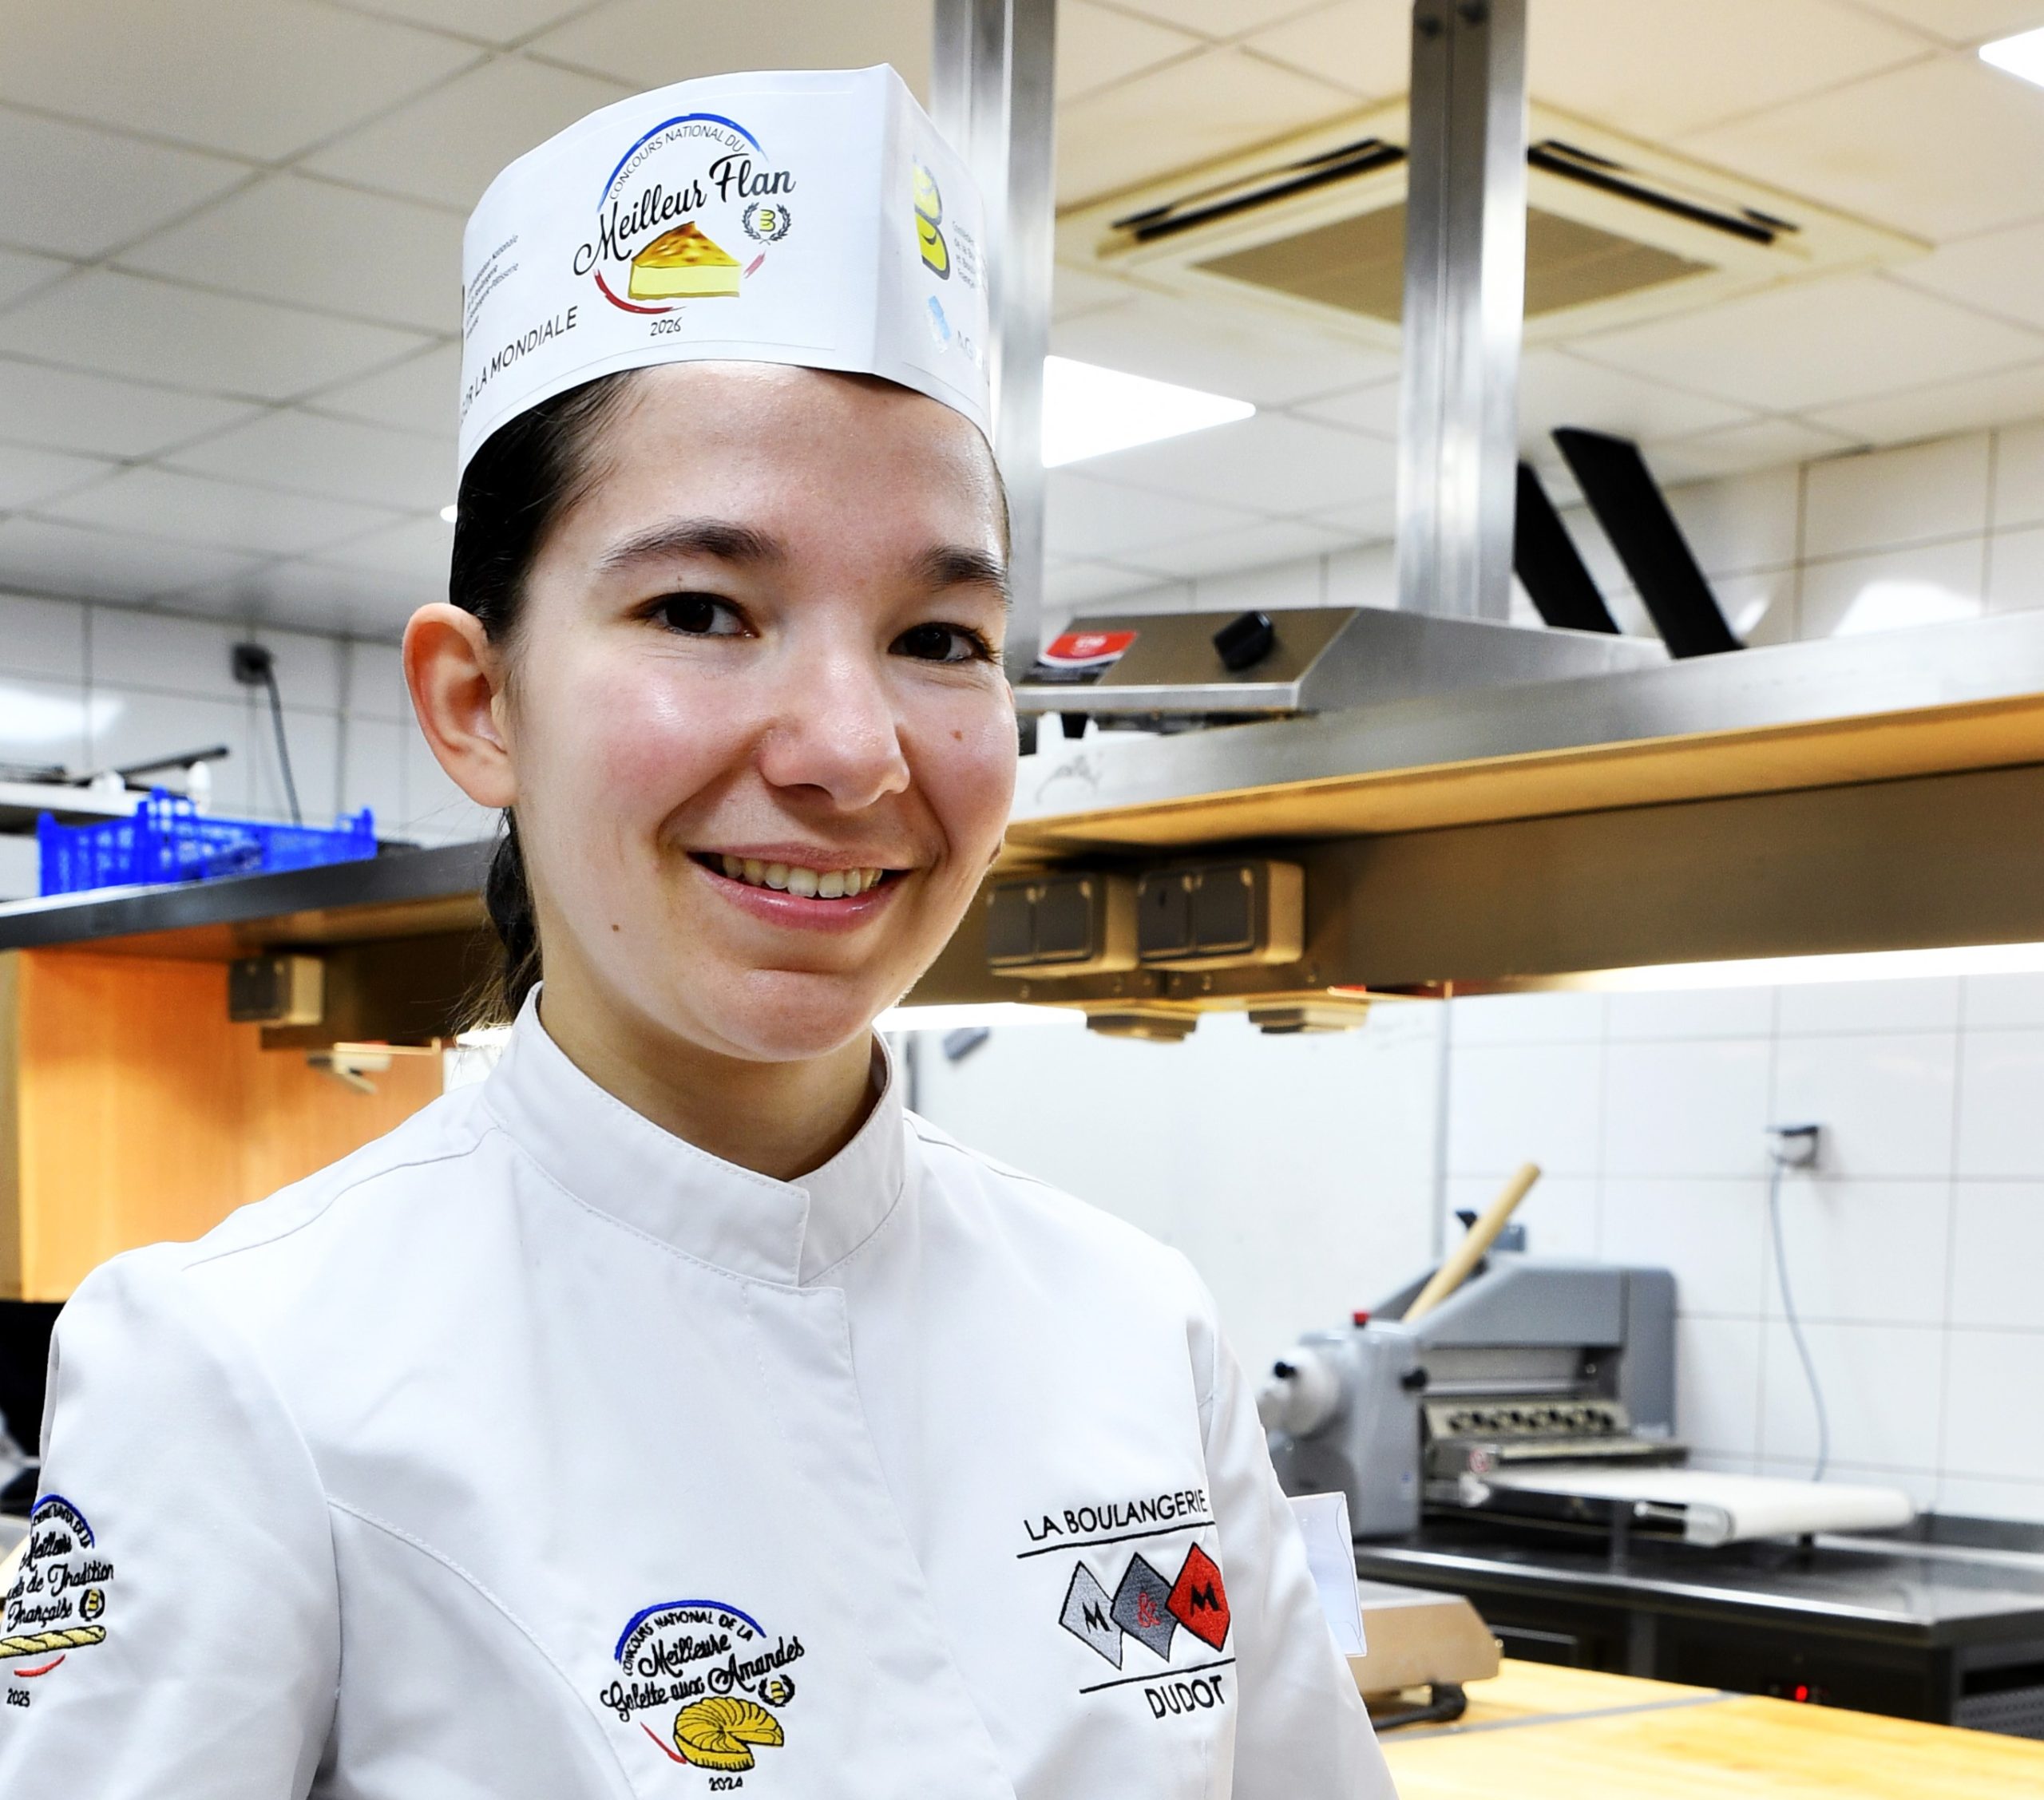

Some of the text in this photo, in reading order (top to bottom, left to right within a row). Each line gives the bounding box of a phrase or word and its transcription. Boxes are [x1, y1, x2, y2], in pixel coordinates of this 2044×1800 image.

[609, 125, 746, 200] CONCOURS NATIONAL DU
[573, 152, 796, 275] Meilleur Flan
[474, 305, 578, 398] LA MONDIALE
[650, 317, 682, 336] 2026
[1024, 1489, 1207, 1541] LA BOULANGERIE
[48, 1560, 114, 1597] Tradition
[654, 1611, 714, 1629] NATIONAL
[719, 1614, 737, 1630] DE
[737, 1624, 753, 1641] LA
[1082, 1601, 1112, 1634] M
[1190, 1581, 1221, 1617] M
[638, 1634, 732, 1678] Meilleure
[707, 1635, 805, 1695] Amandes
[1144, 1675, 1226, 1719] DUDOT
